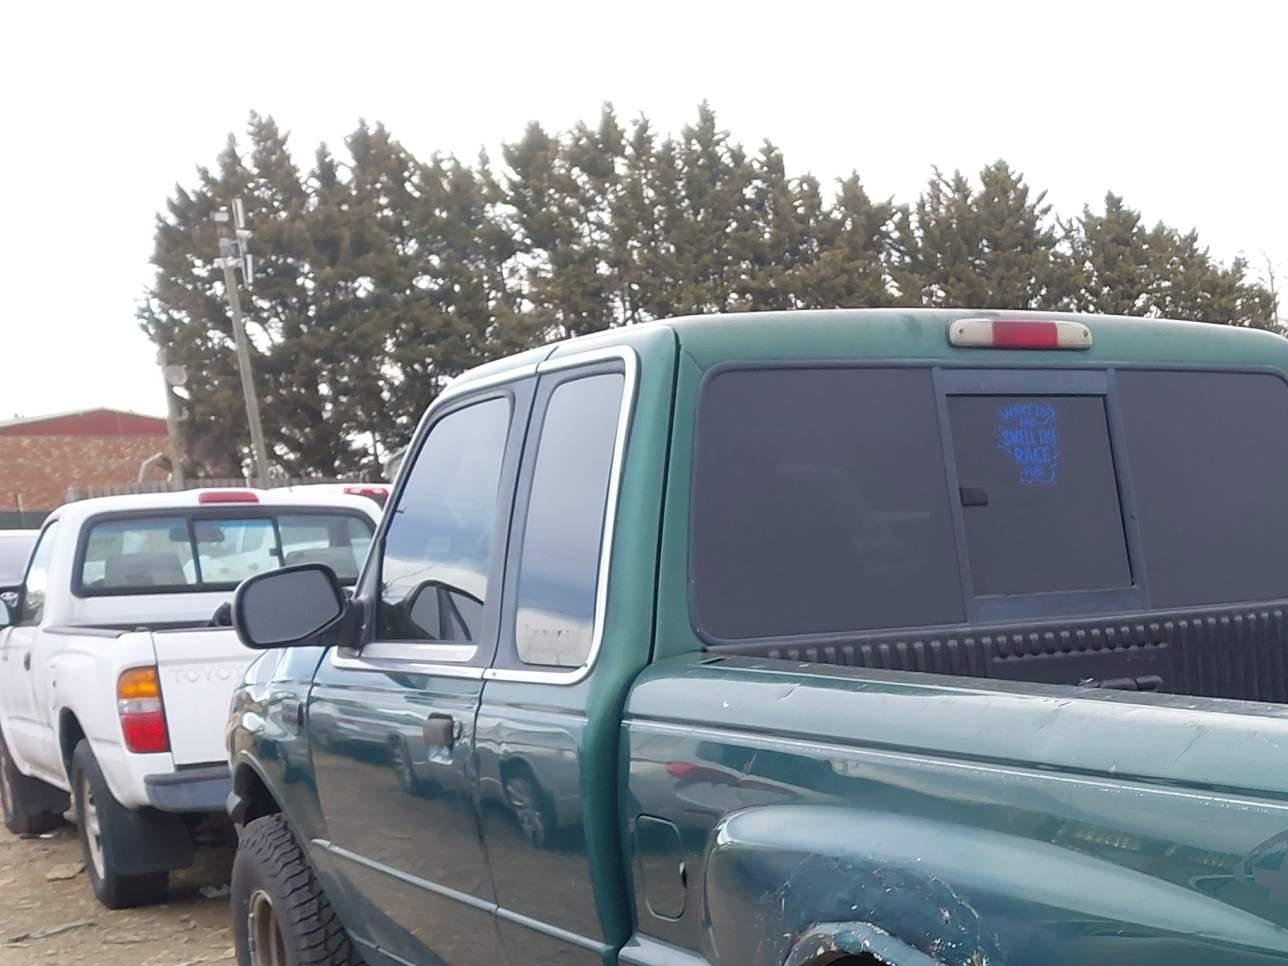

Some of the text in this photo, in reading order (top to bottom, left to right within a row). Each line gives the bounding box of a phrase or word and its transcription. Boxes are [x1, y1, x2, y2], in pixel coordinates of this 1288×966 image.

[1002, 428, 1037, 447] SMELL
[1014, 446, 1052, 464] RACE
[169, 662, 244, 684] TOYOT
